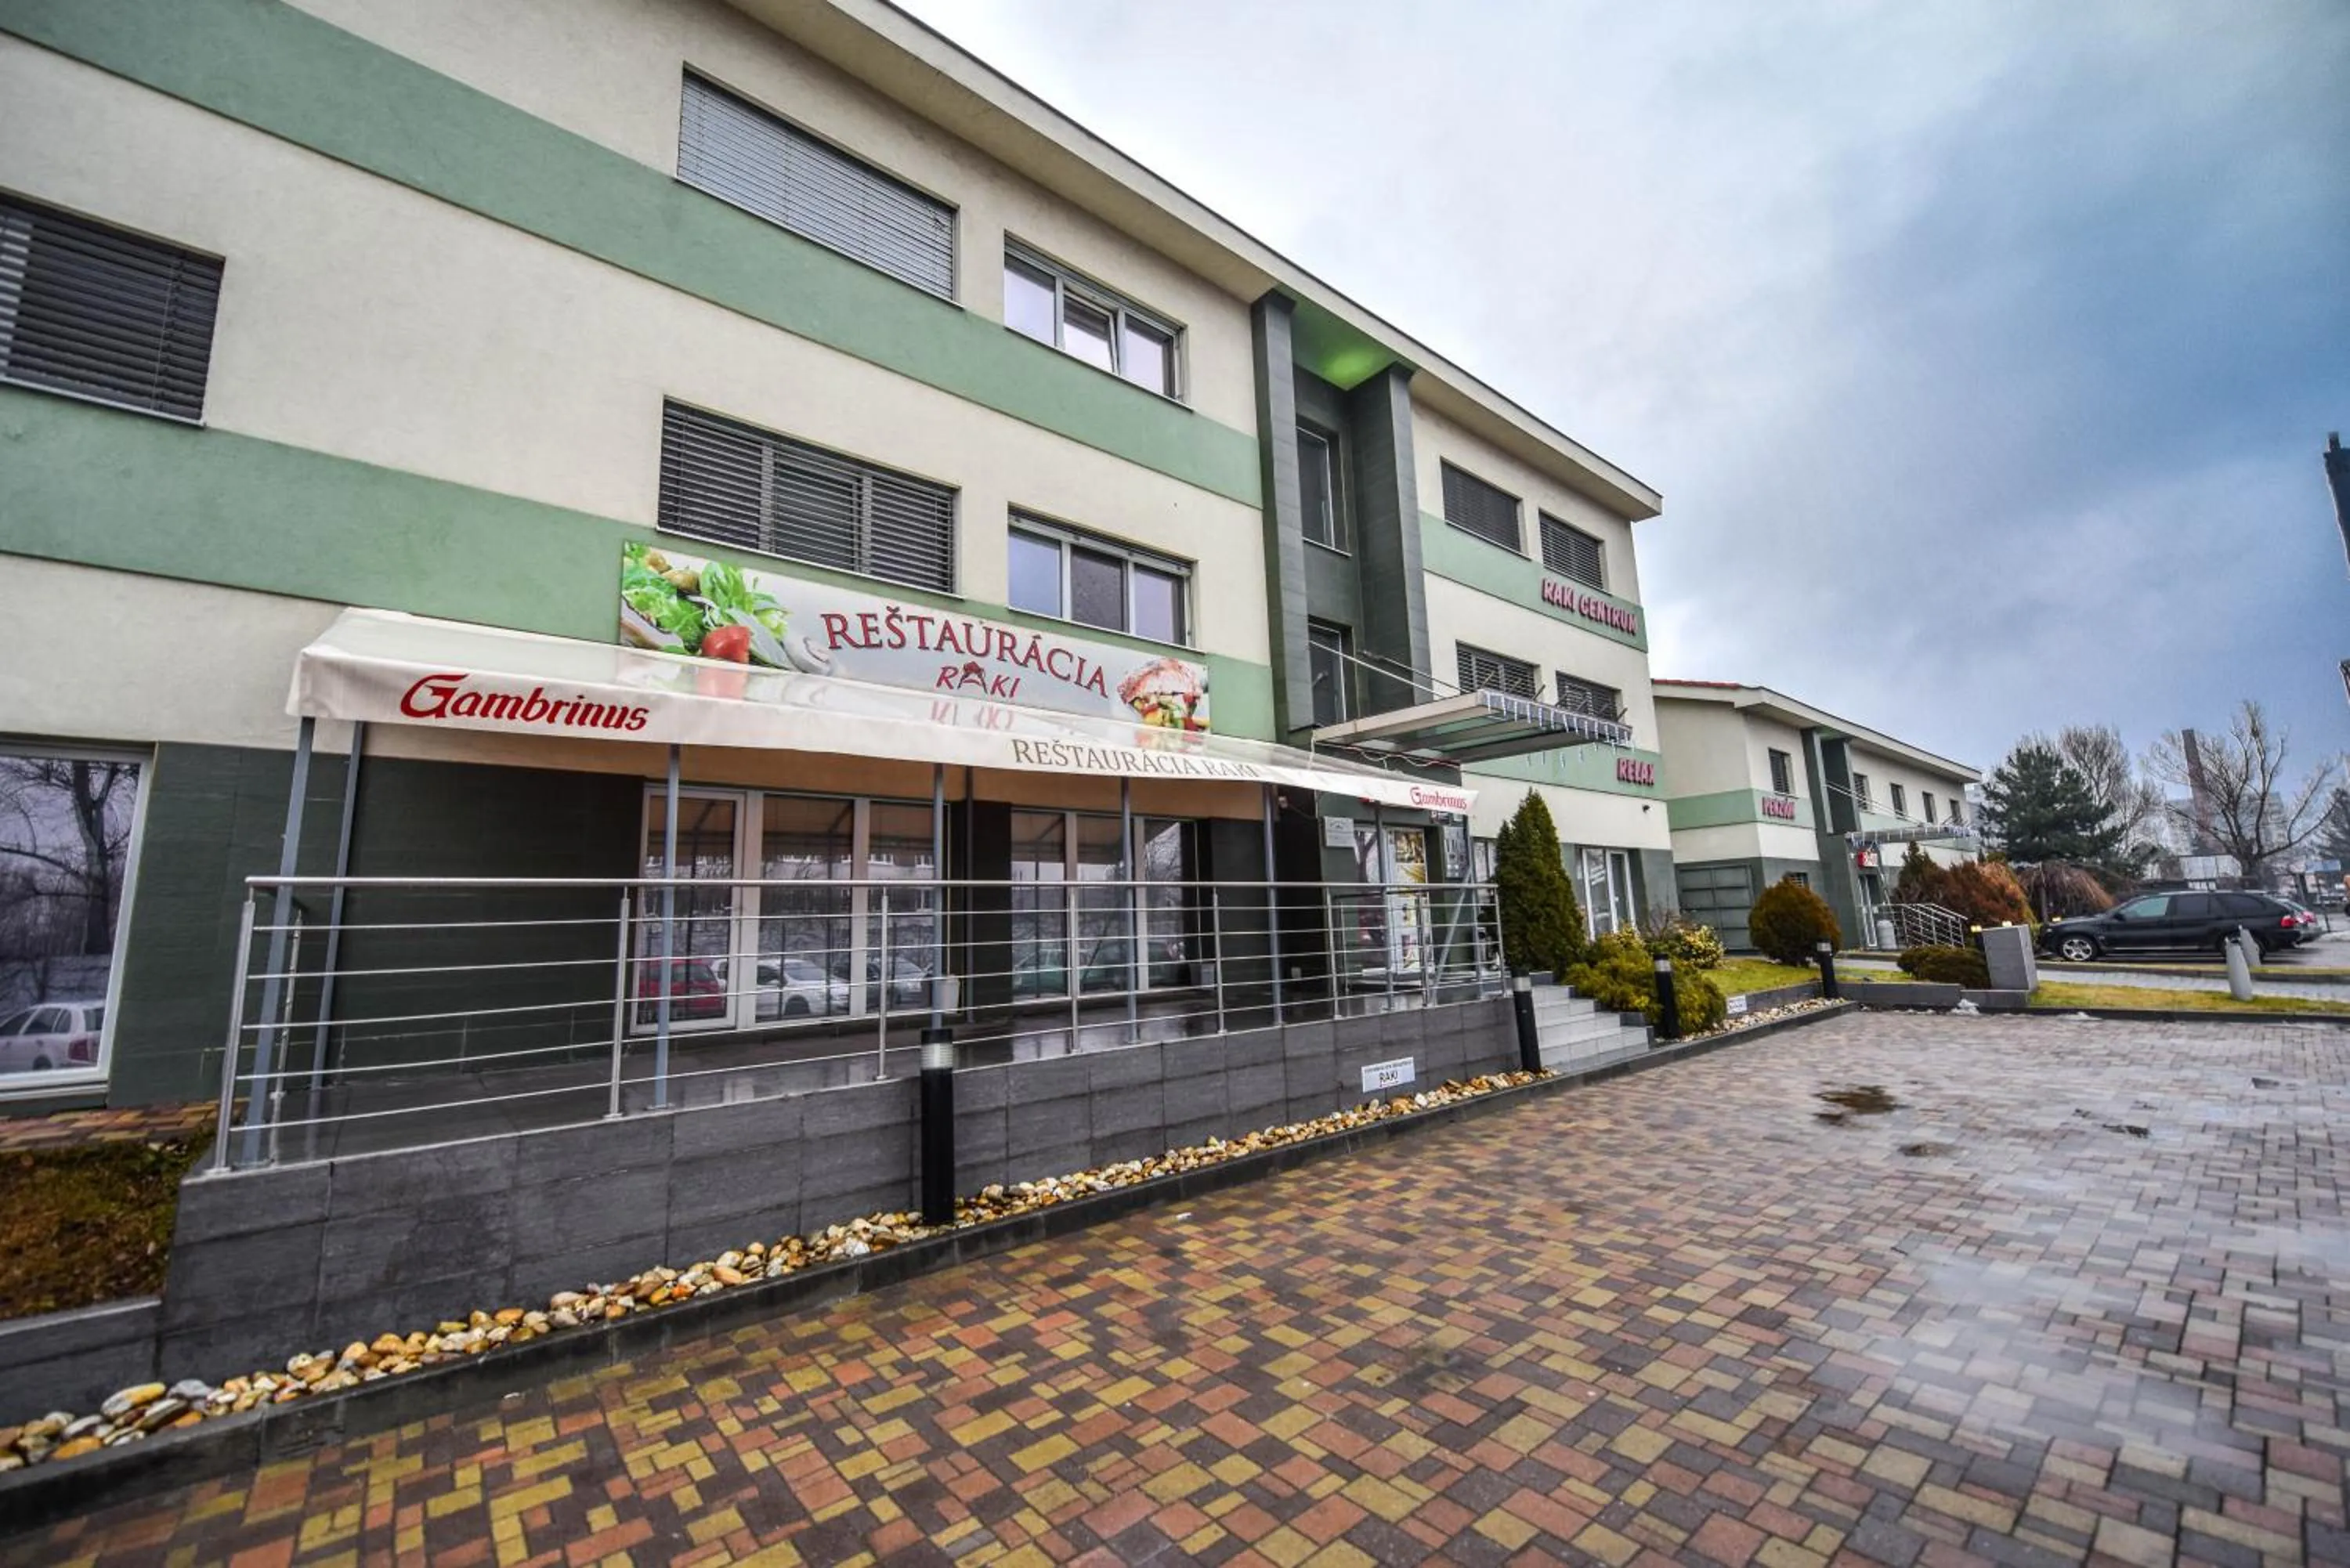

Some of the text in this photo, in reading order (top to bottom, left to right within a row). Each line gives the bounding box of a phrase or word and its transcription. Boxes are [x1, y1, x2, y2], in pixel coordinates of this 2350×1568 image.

[1542, 578, 1637, 635] RAKI CENTRUM
[821, 606, 1108, 698] REŠTAURÁCIA
[400, 674, 649, 732] Gambrinus
[936, 661, 1021, 698] RAKI
[1011, 738, 1201, 775] REŠTAURÁCIA
[1617, 757, 1654, 786] RELAX
